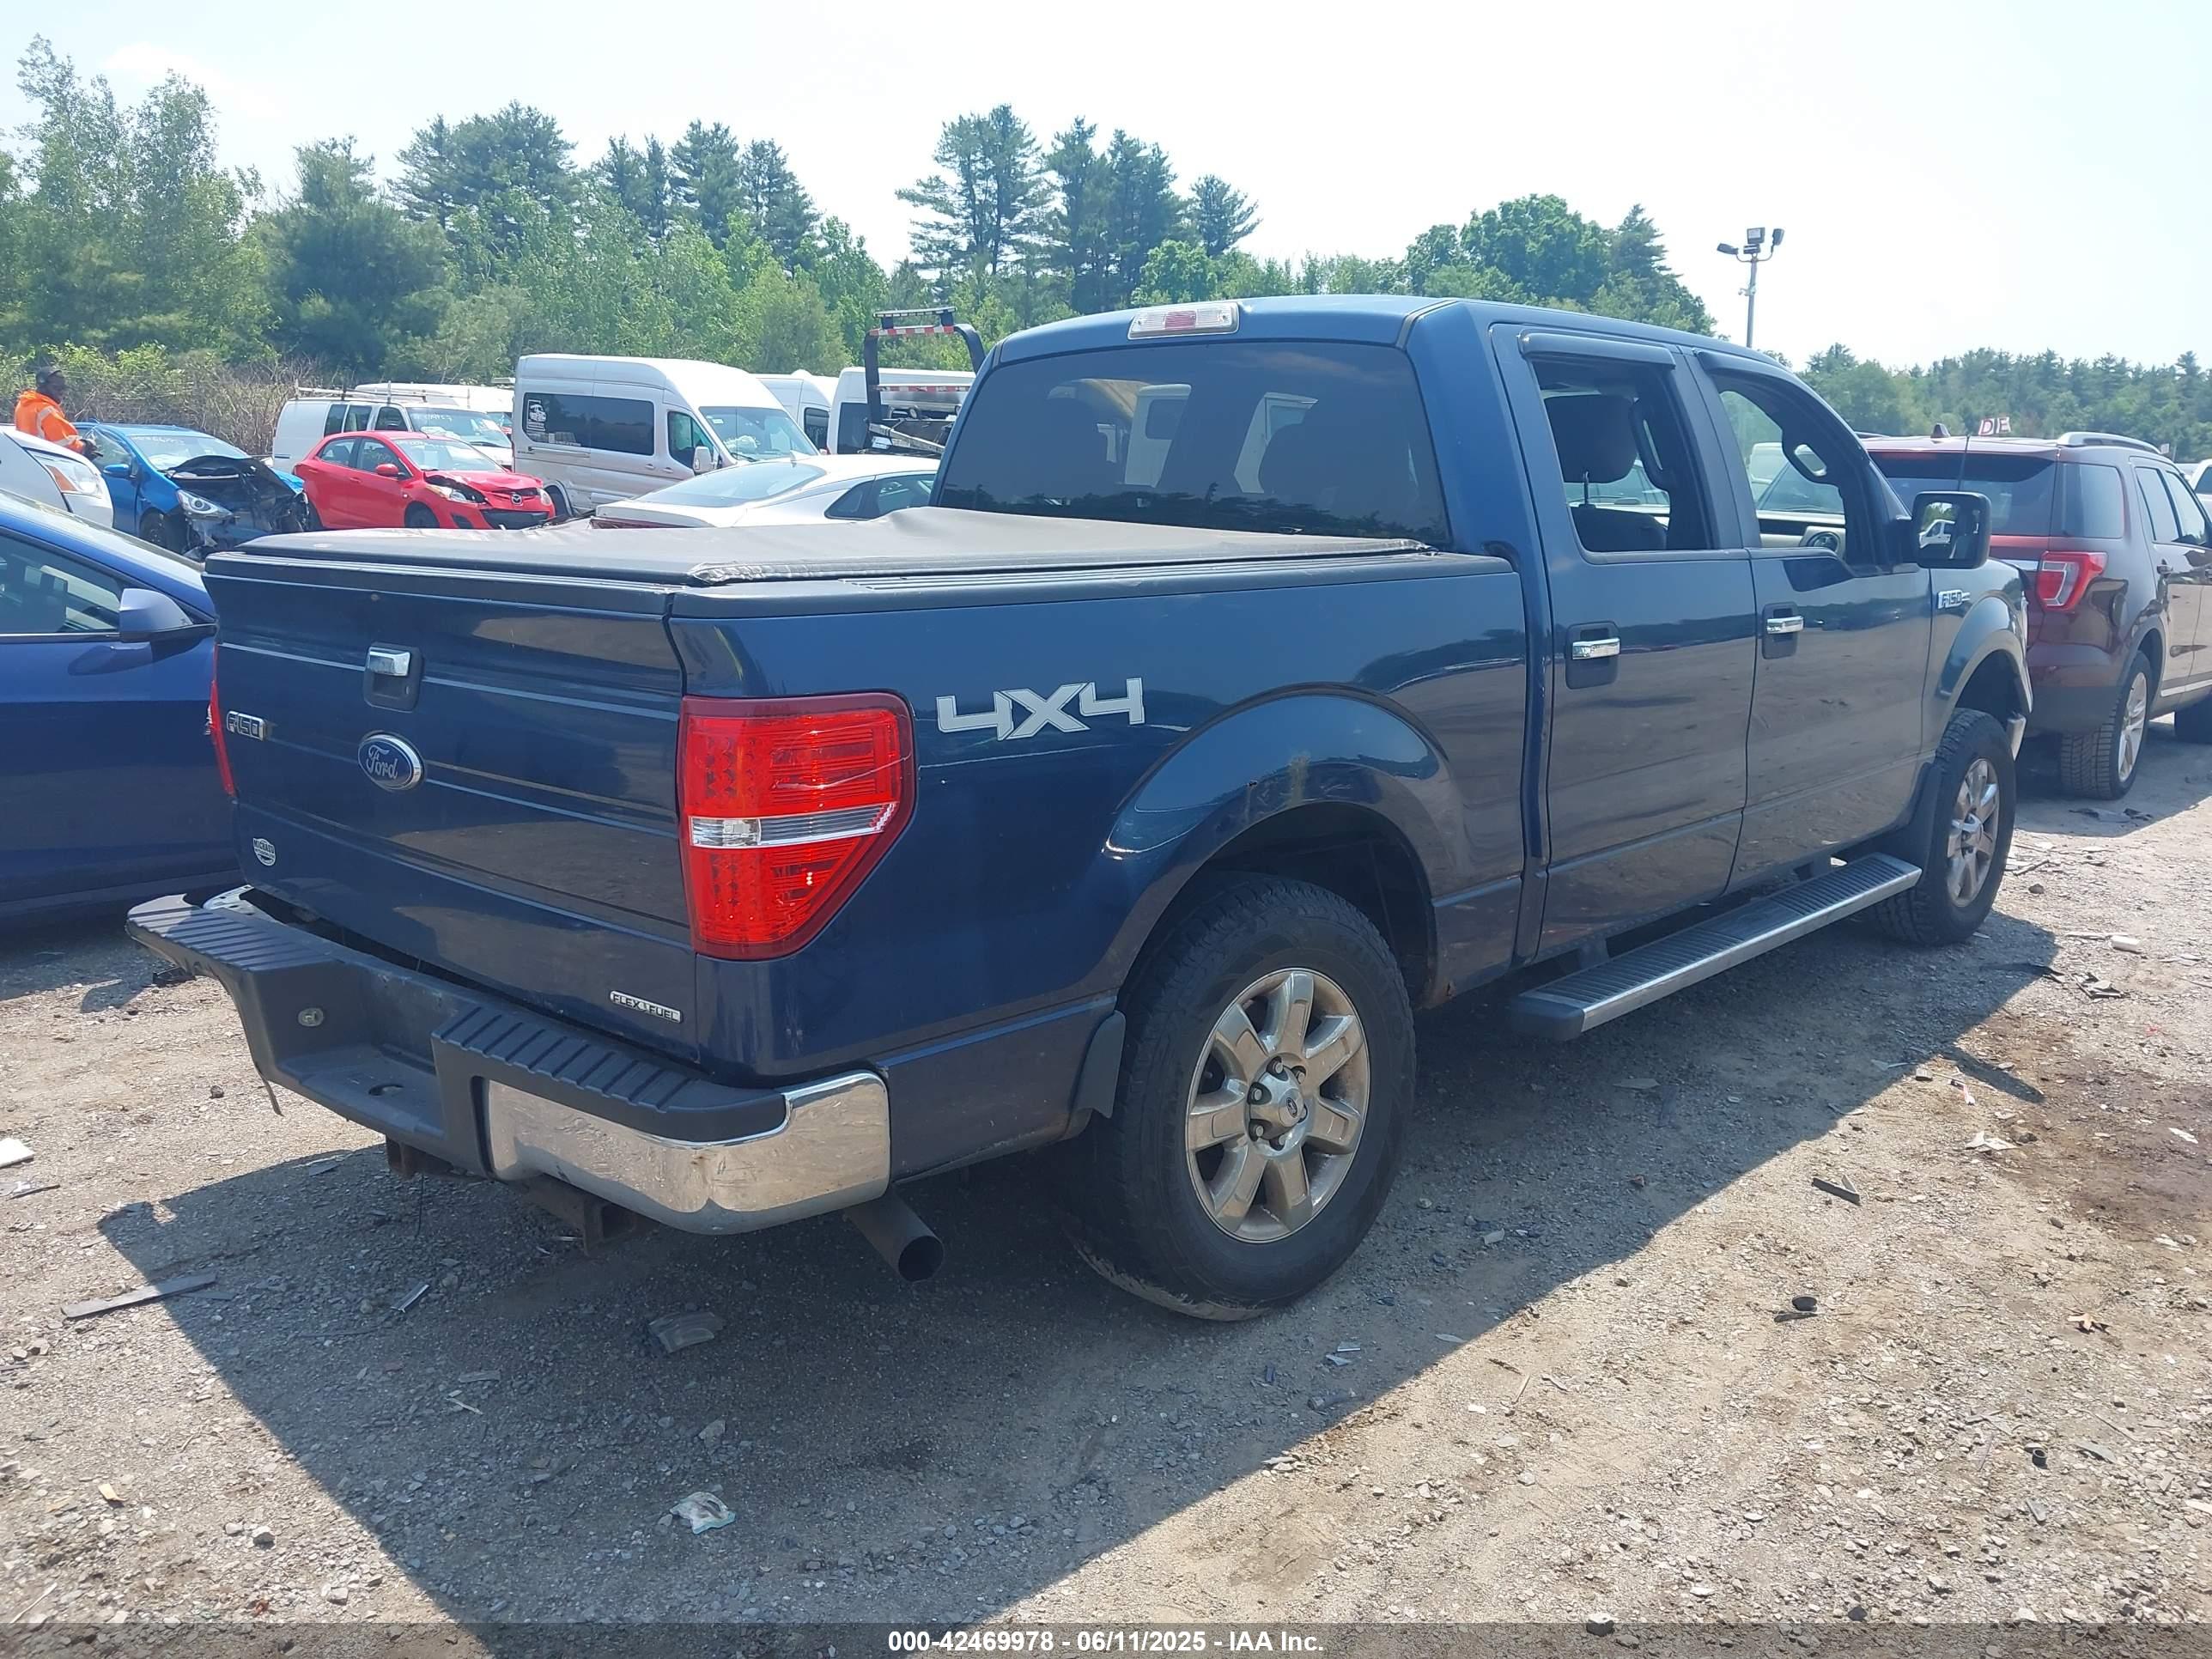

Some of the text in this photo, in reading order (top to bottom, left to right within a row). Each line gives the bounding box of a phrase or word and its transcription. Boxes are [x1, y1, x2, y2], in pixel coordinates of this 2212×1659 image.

[366, 744, 398, 780] Ford
[612, 994, 681, 1022] FLEX FUEL
